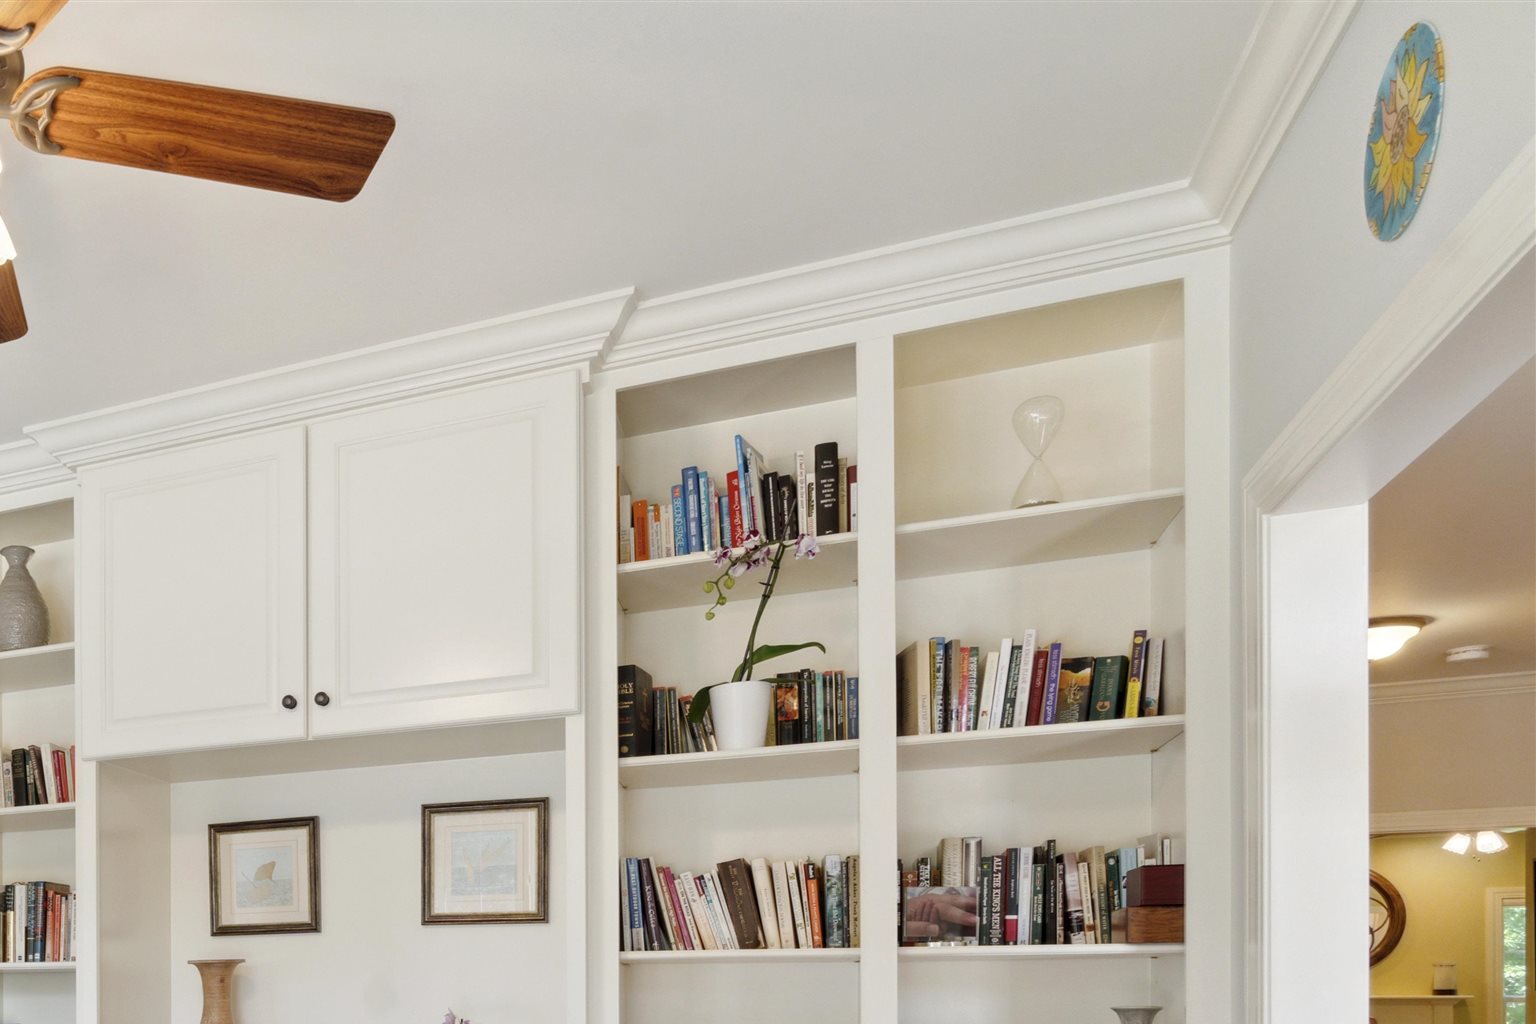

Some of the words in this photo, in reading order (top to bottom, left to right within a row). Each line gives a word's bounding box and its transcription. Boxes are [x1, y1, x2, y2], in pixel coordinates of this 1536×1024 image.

[674, 497, 683, 526] SECOND
[675, 527, 685, 548] STAGE
[967, 656, 978, 678] ROBERT
[1048, 682, 1056, 693] the
[1046, 693, 1055, 706] lying
[993, 856, 1002, 873] ALL
[993, 873, 1002, 888] THE
[992, 889, 1001, 912] KING'S
[992, 913, 1000, 930] MEN
